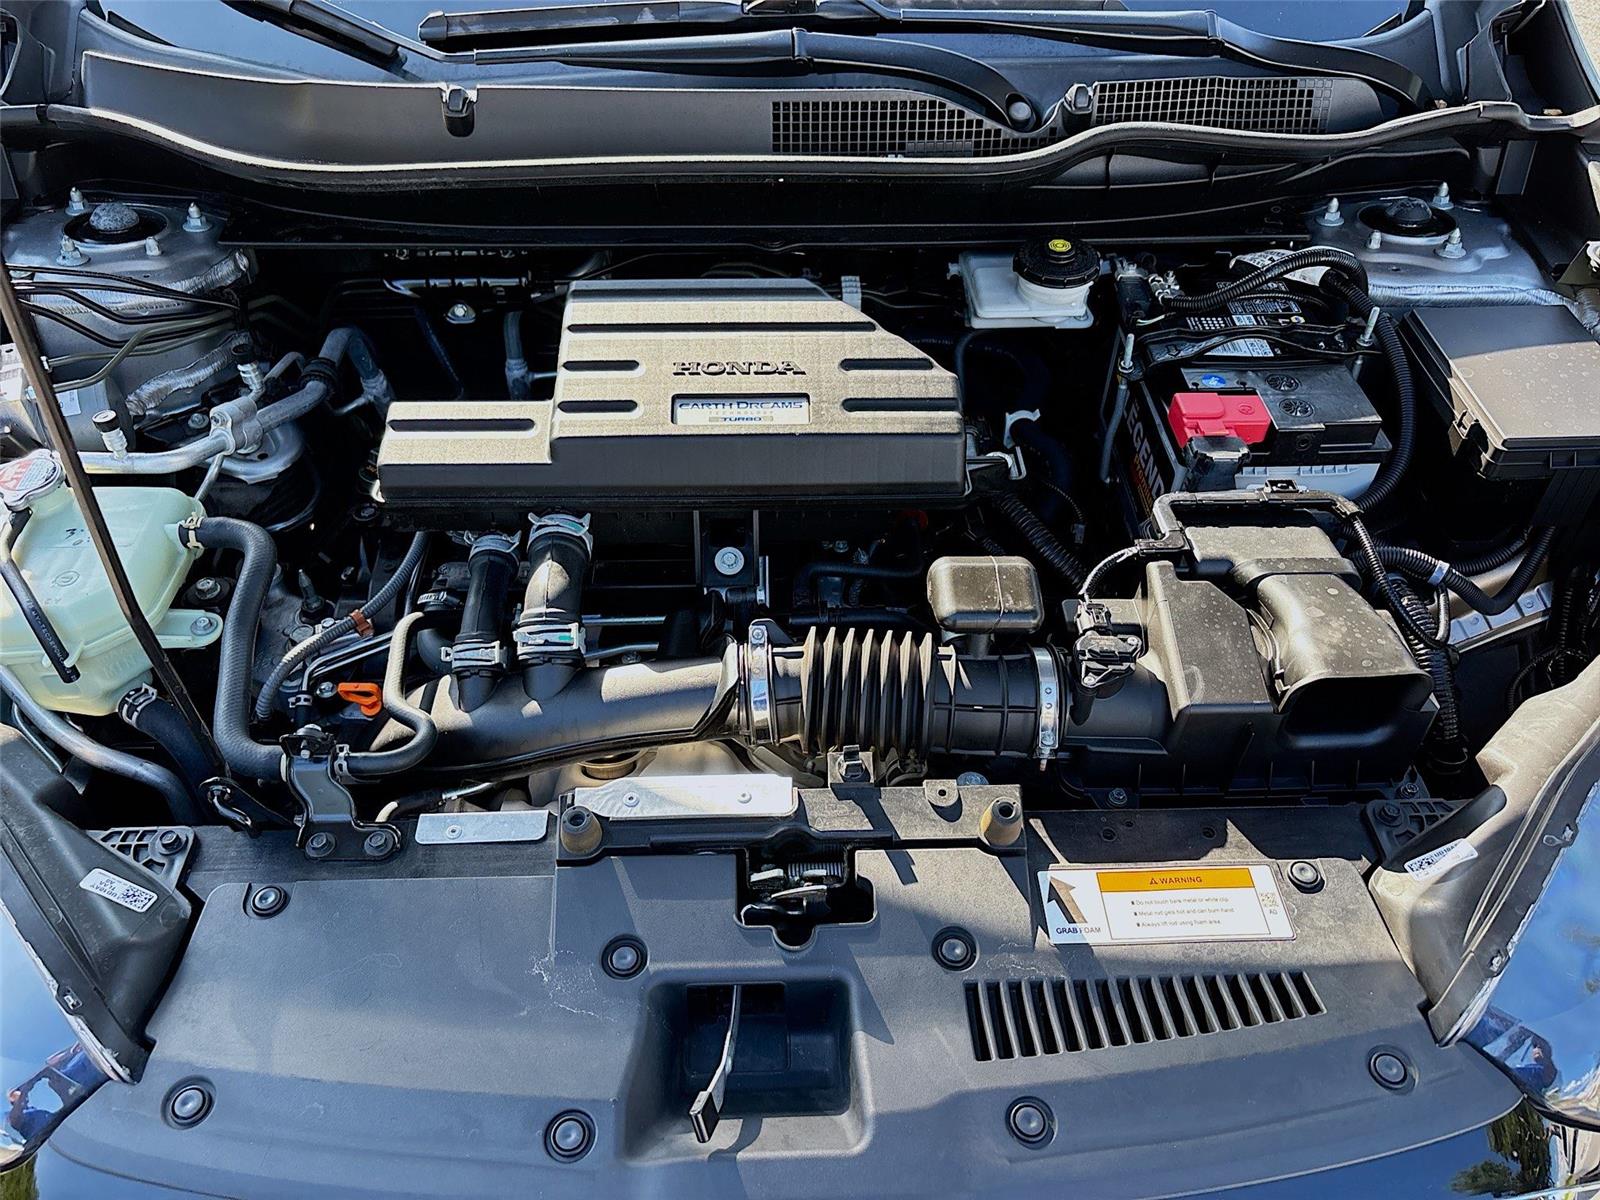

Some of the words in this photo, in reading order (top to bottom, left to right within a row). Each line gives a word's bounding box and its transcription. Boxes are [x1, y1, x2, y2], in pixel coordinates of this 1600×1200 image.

[672, 360, 807, 376] HONDA
[736, 401, 803, 409] DREAMS
[1123, 403, 1165, 500] EGEND
[1158, 876, 1203, 885] WARNING
